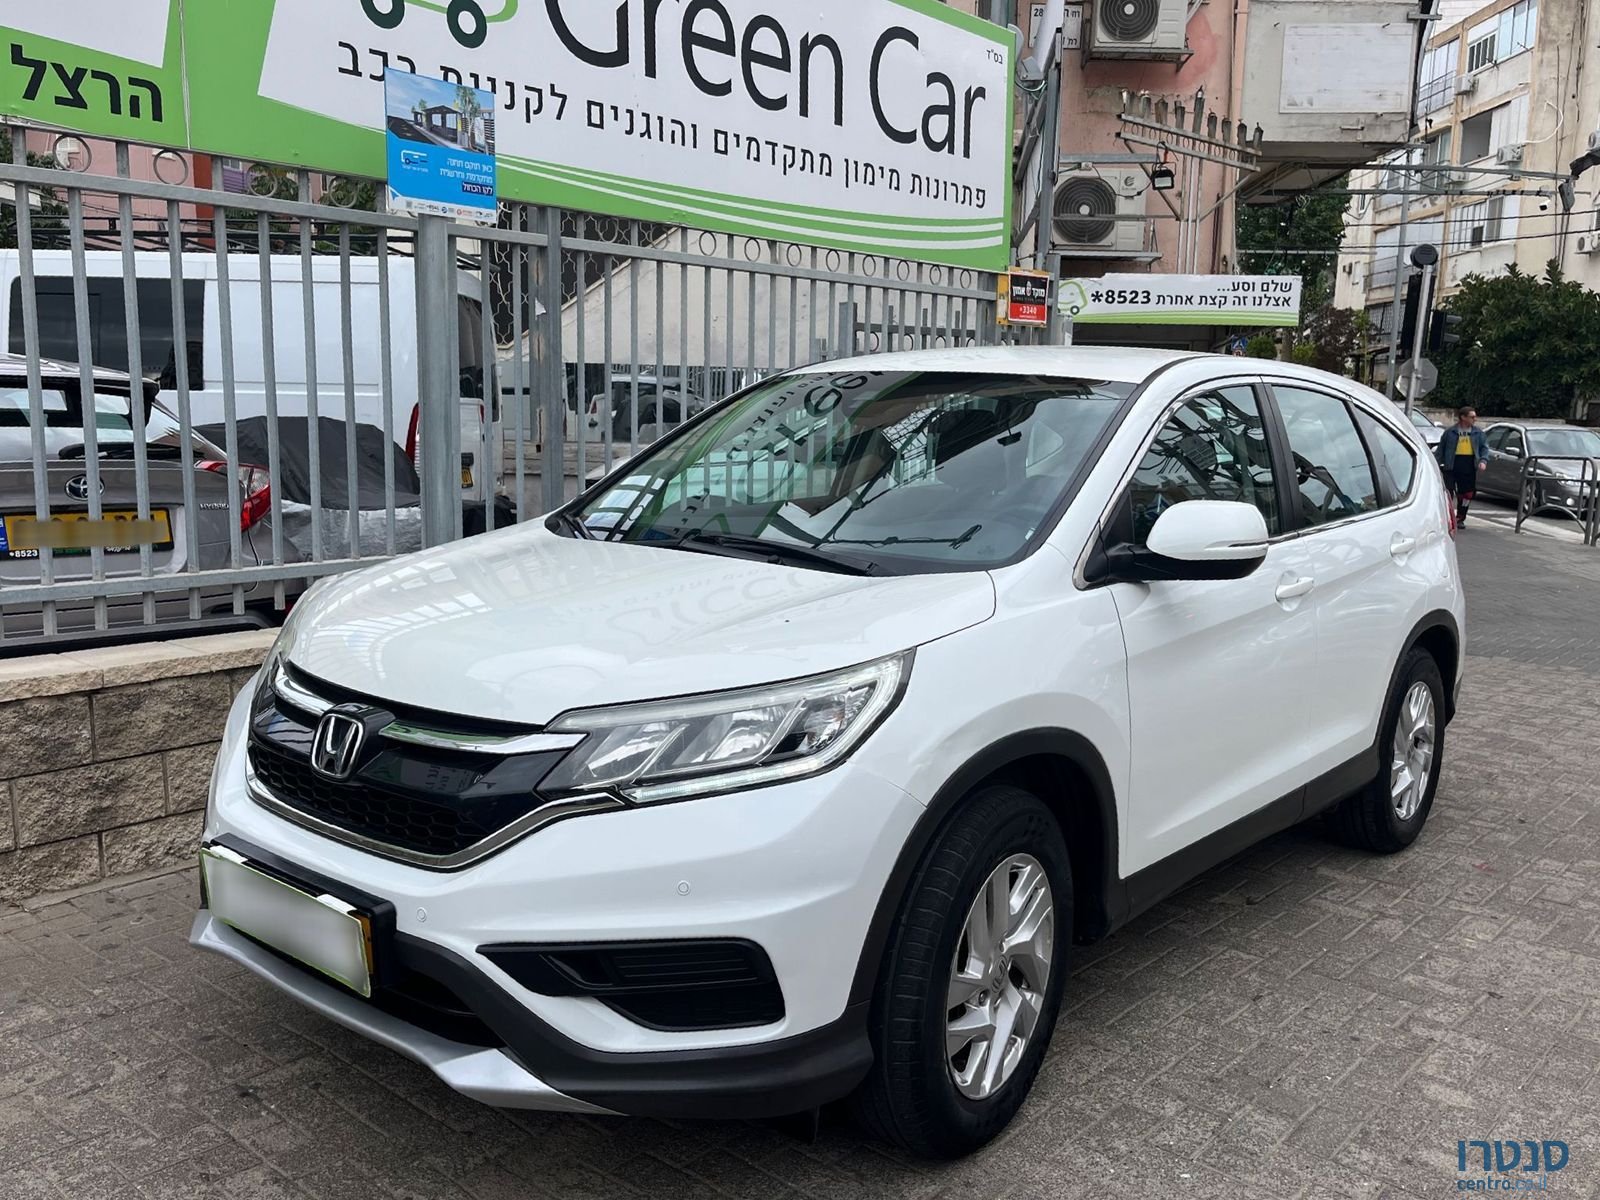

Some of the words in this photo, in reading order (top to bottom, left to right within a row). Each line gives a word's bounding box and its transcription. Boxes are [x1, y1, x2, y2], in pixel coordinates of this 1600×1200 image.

[1033, 8, 1044, 17] 28
[10, 43, 163, 123] הרצל
[869, 26, 986, 159] Car
[587, 99, 697, 149] והוגנים
[714, 128, 834, 177] מתקדמים
[844, 158, 901, 191] מימון
[910, 173, 986, 209] פתרונות
[1260, 280, 1292, 292] שלם
[1155, 294, 1194, 306] אחרת
[1198, 294, 1227, 309] קצת
[1232, 294, 1248, 306] זה
[1252, 293, 1291, 307] אצלנו
